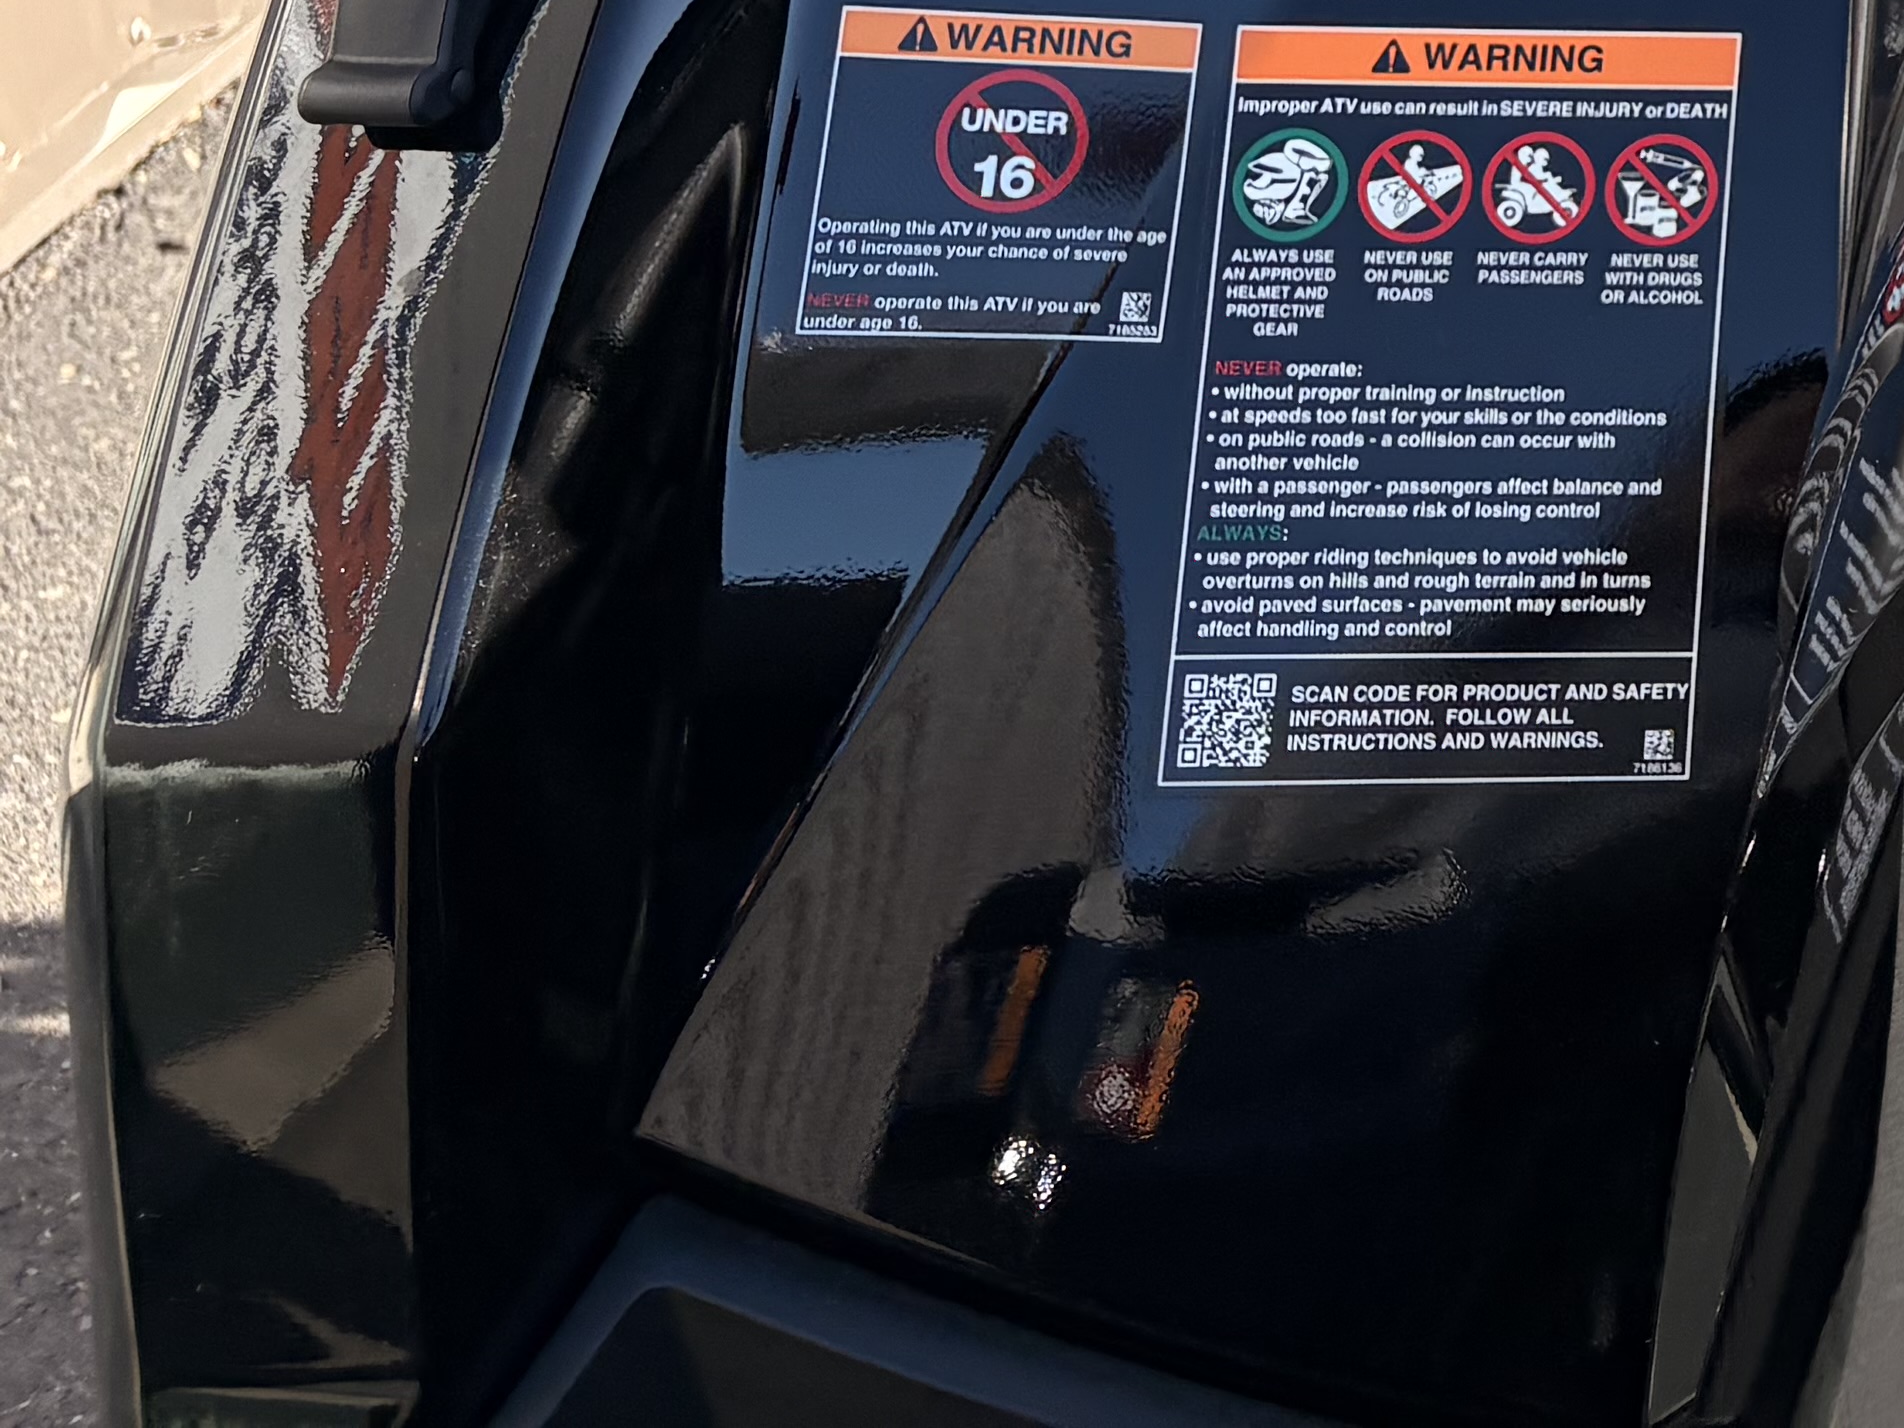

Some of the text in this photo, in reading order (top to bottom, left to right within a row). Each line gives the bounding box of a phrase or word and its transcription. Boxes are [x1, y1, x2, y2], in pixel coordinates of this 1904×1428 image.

[947, 22, 1131, 58] WARNING
[1424, 42, 1603, 73] WARNING
[961, 107, 1068, 135] UNDER
[973, 154, 1035, 198] 16
[814, 216, 1166, 246] Operating this ATV if you are under the age
[1231, 248, 1334, 263] ALWAYS USE
[1364, 250, 1453, 265] NEVER USE
[1477, 251, 1588, 266] NEVER CARRY
[1610, 253, 1698, 268] NEVER USE
[811, 259, 938, 278] injury or death.
[1222, 266, 1336, 281] AN APPROVED
[1364, 268, 1449, 283] ON PUBLIC
[1477, 269, 1584, 284] PASSENGERS
[1605, 271, 1702, 286] WITH DRUGS
[1226, 284, 1328, 300] HELMET AND
[1377, 287, 1433, 301] ROADS
[1600, 289, 1703, 304] OR ALCOHOL
[1225, 303, 1324, 318] PROTECTIVE
[803, 314, 923, 332] under age 16.
[1253, 321, 1298, 336] GEAR
[1215, 360, 1362, 380] NEVER operate:
[1224, 383, 1564, 405] without proper training or instruction
[1291, 682, 1690, 703] SCAN CODE FOR PRODUCT AND SAFETY
[1289, 707, 1573, 726] INFORMATION. FOLLOW ALL
[1286, 731, 1603, 751] INSTRUCTIONS AND WARNINGS.
